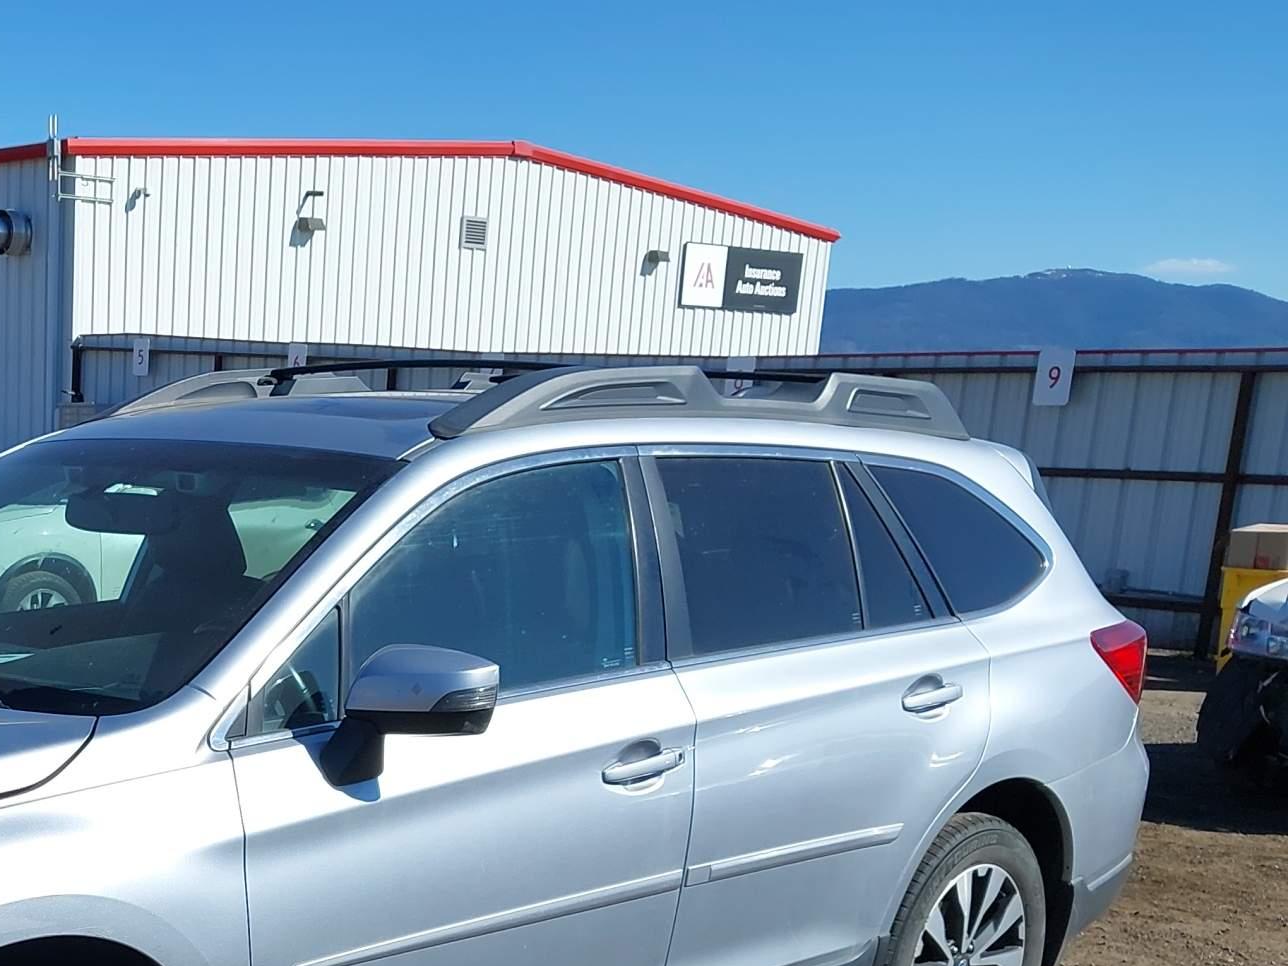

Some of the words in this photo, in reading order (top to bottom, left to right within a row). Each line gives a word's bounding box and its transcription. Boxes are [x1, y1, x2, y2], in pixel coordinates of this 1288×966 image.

[744, 264, 782, 281] Insurance
[735, 279, 754, 295] Auto
[754, 280, 787, 297] Auctions
[138, 349, 144, 365] 5
[1048, 366, 1061, 389] 9
